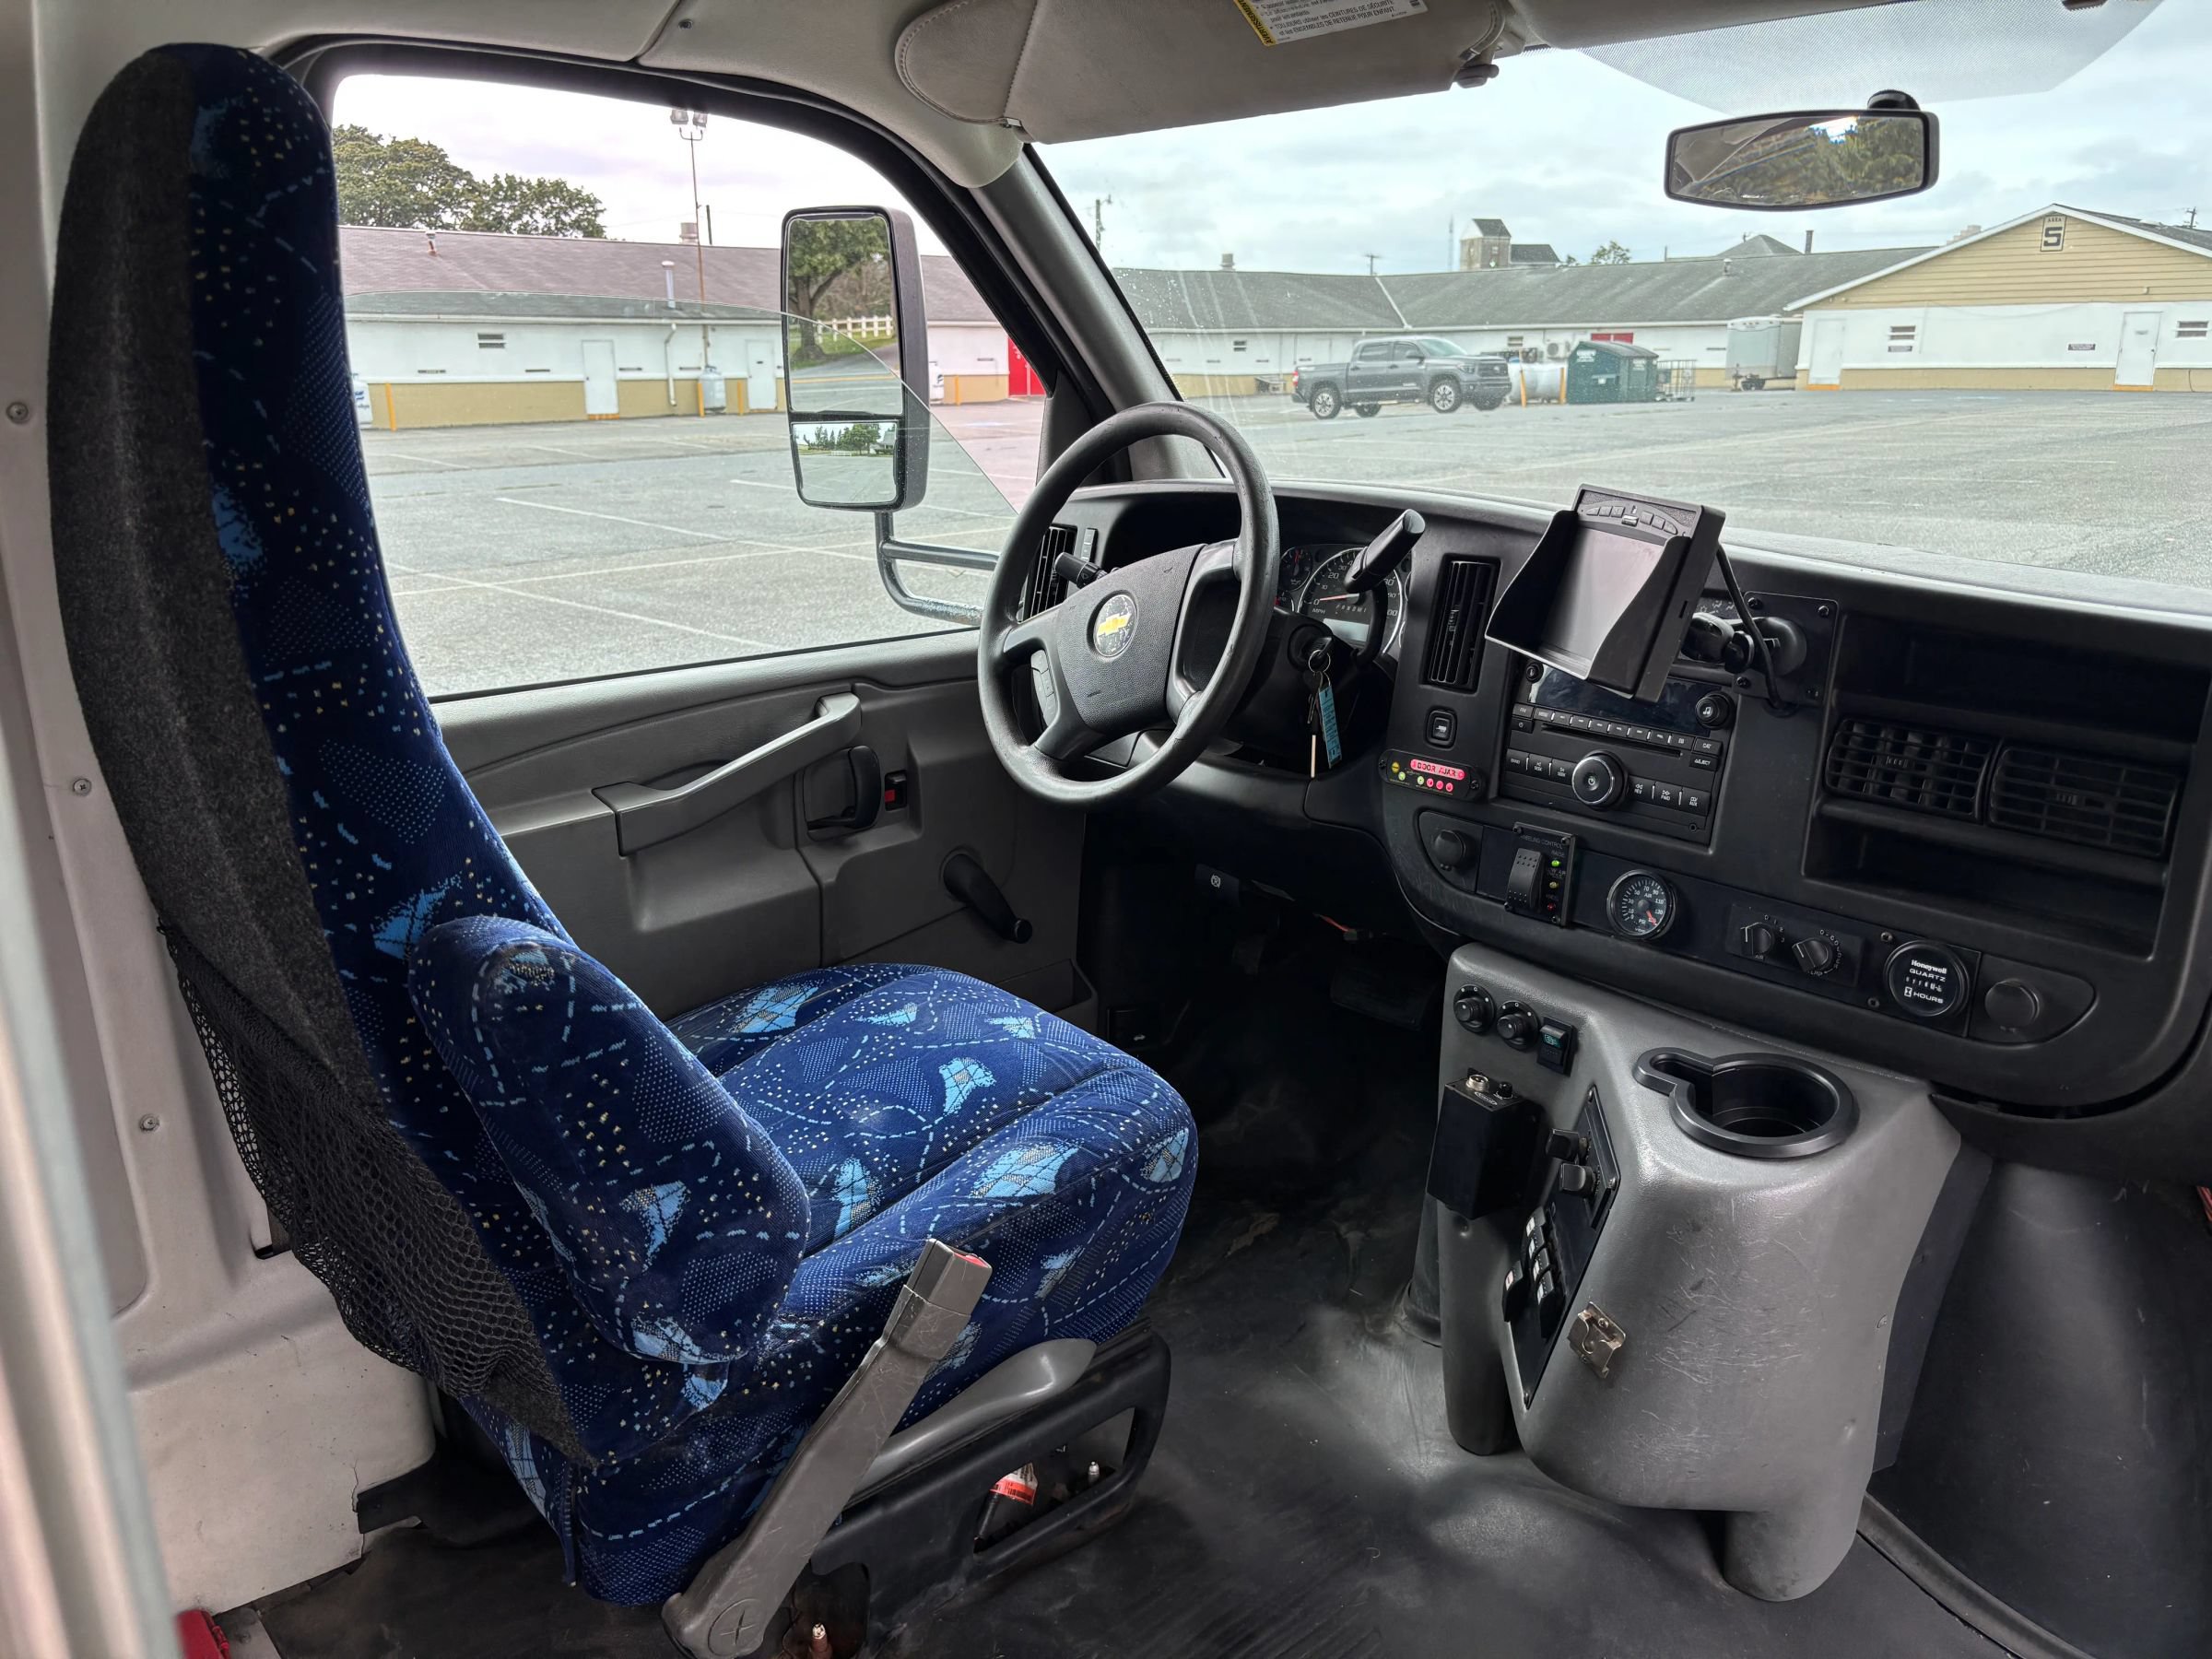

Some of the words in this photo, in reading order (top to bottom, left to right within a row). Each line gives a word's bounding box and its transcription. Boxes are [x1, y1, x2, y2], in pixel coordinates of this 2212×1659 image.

[1328, 571, 1339, 580] 20
[1417, 762, 1436, 772] DOOR
[1438, 767, 1456, 777] AJAR
[1911, 959, 1947, 974] Honeywell
[1910, 968, 1946, 982] QUARTZ
[1913, 991, 1944, 1004] HOURS
